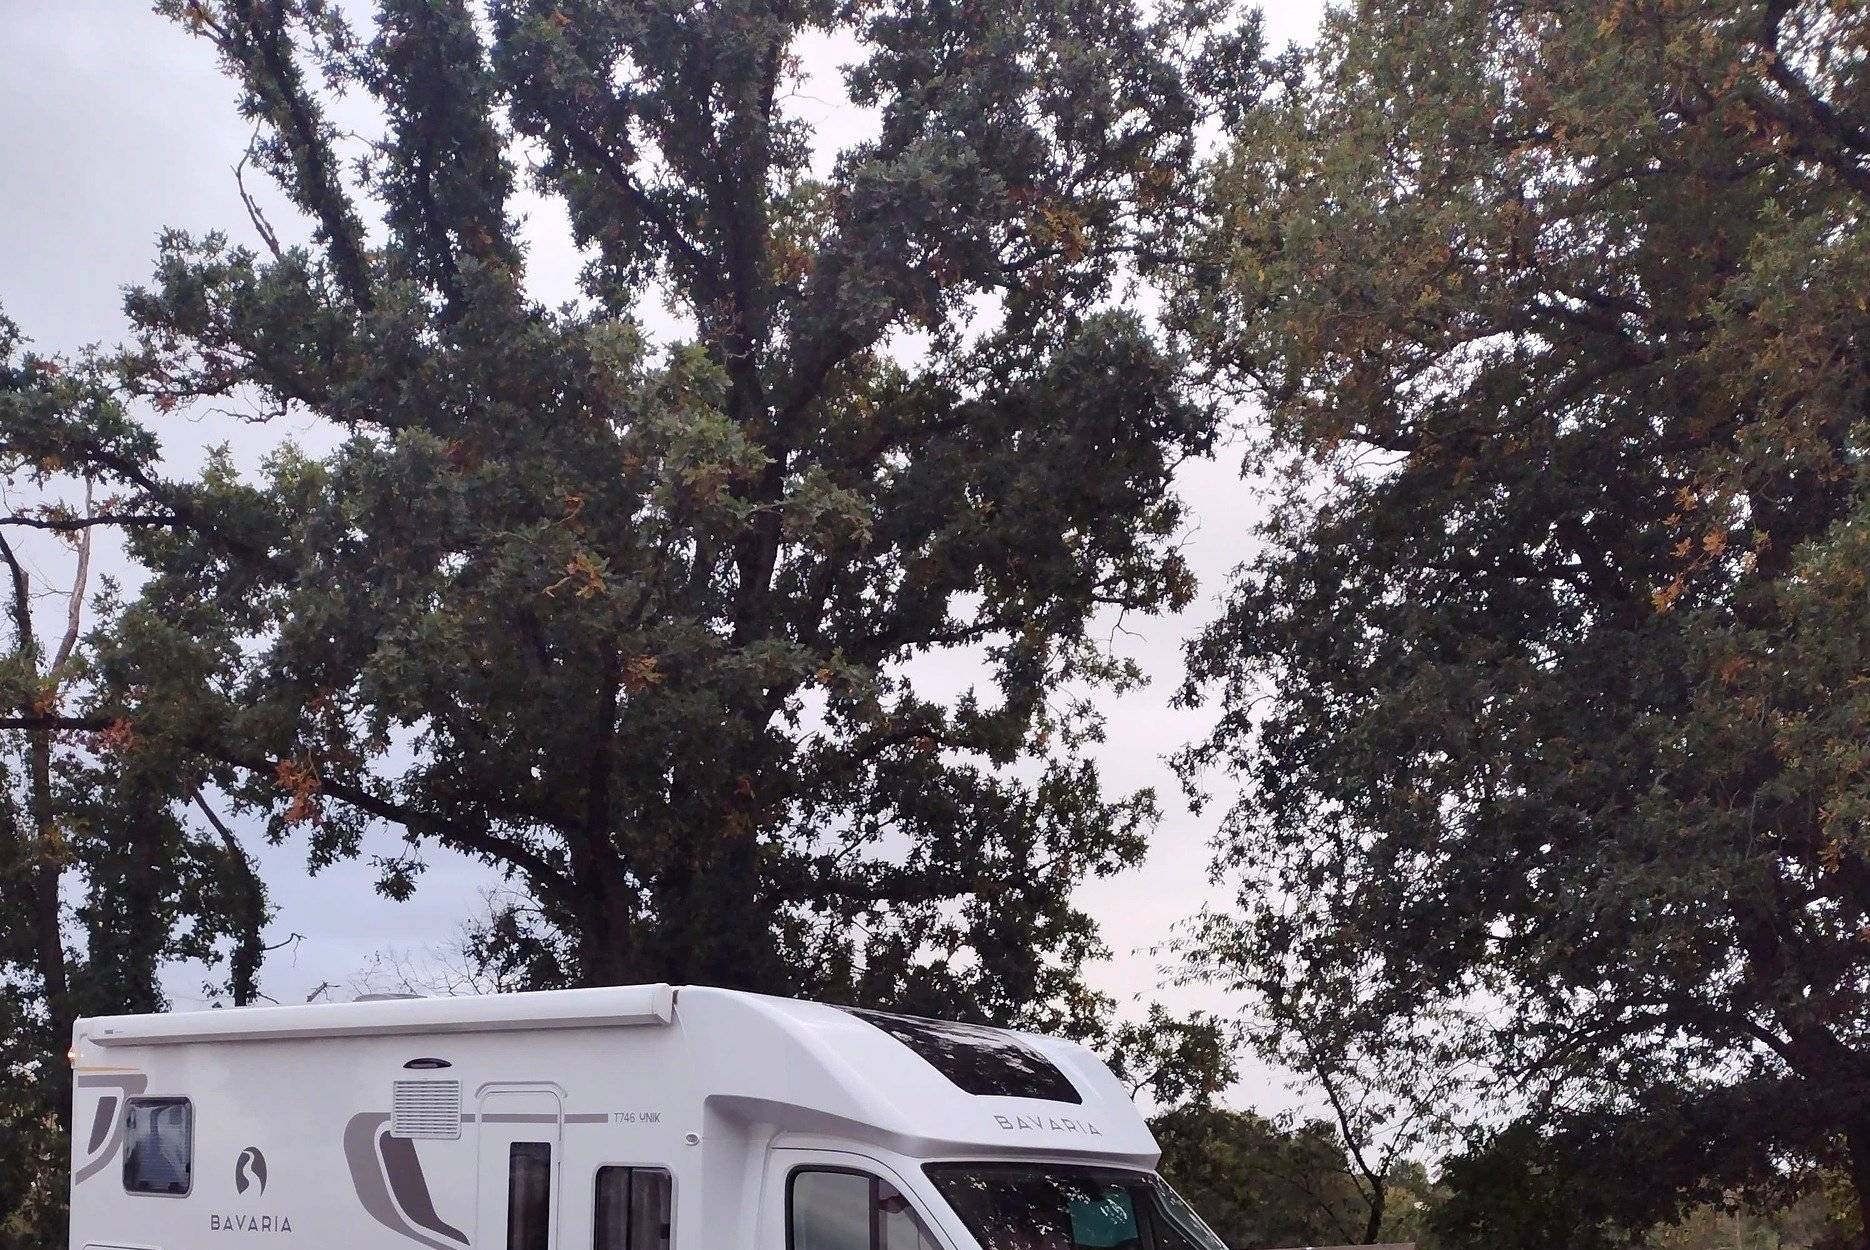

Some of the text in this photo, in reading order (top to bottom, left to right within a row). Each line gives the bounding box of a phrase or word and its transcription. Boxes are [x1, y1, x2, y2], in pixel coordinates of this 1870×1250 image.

[614, 1111, 636, 1123] T746
[993, 1114, 1103, 1137] BAVARIA
[210, 1214, 293, 1233] BAVARIA
